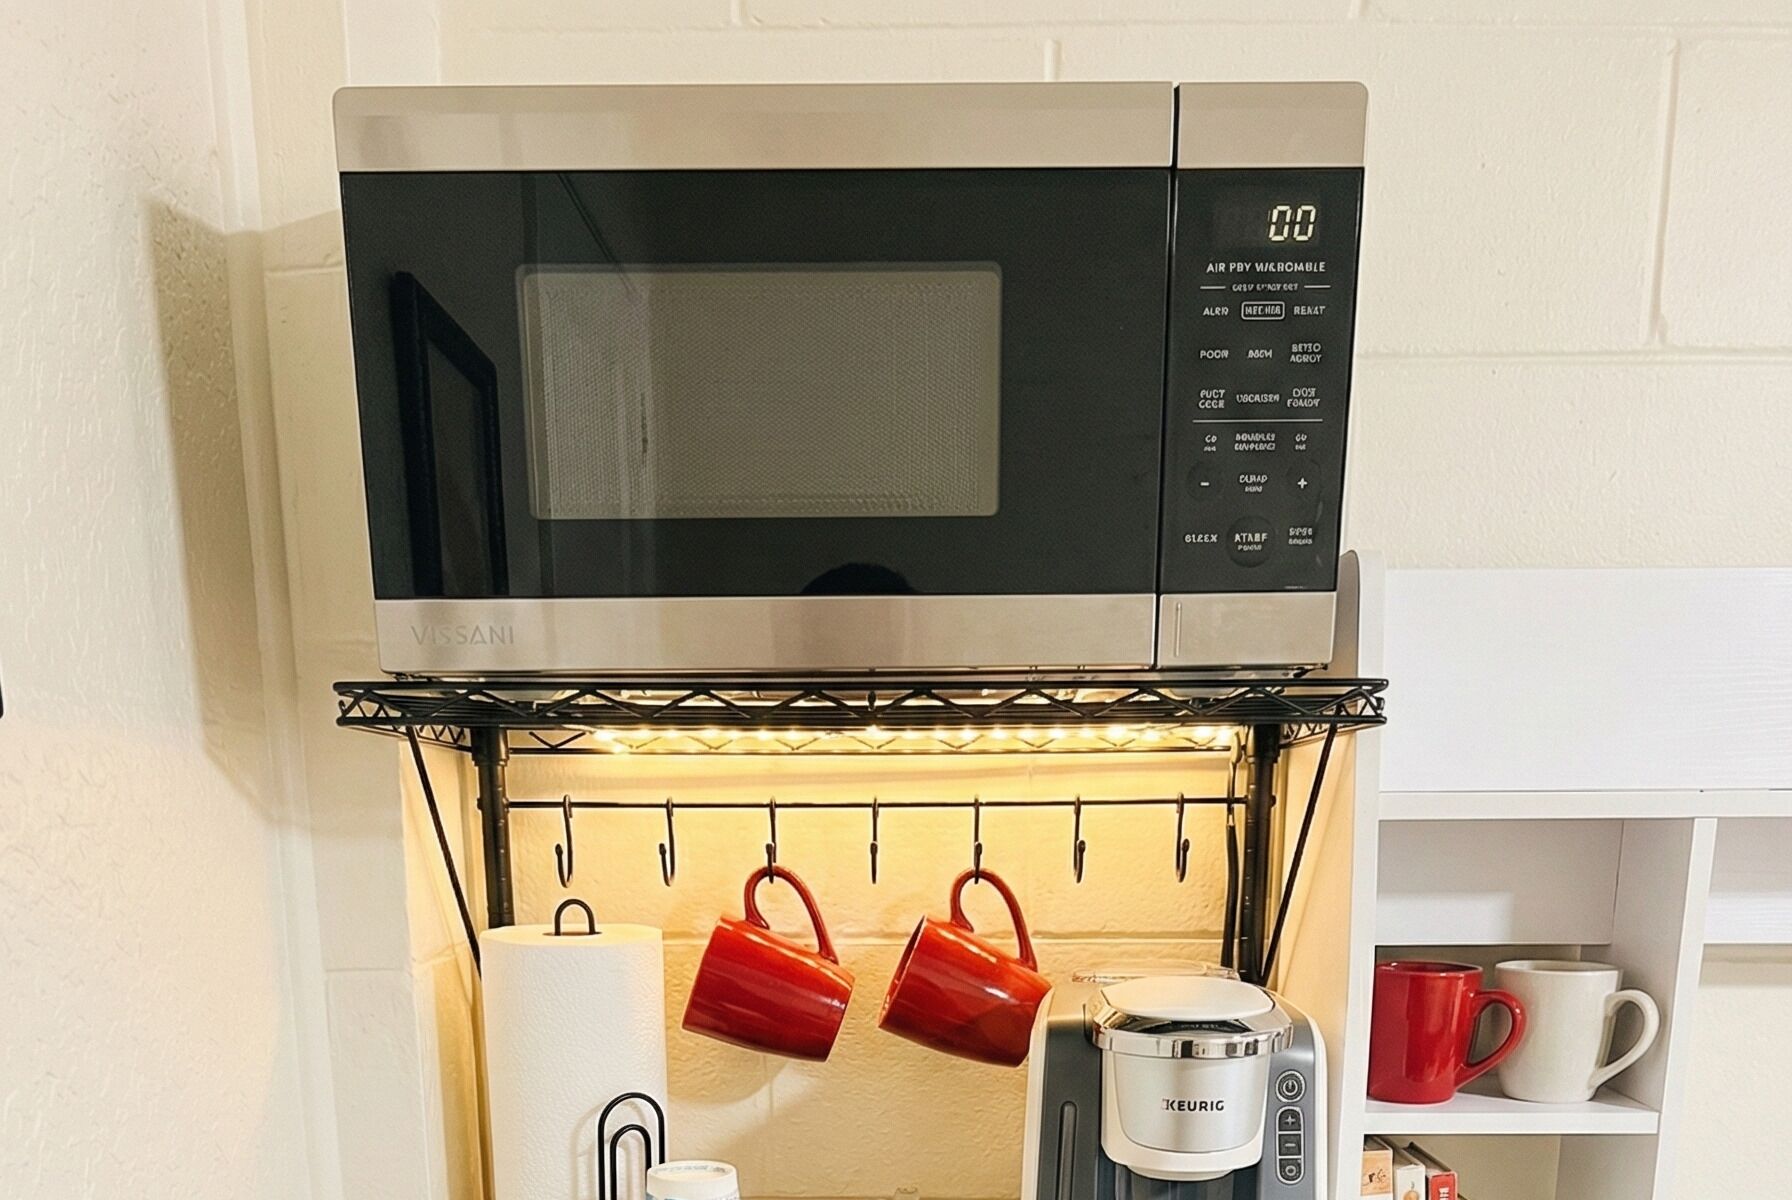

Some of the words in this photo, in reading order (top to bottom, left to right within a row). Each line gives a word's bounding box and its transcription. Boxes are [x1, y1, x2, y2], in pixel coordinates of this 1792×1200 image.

[1267, 204, 1317, 242] 00
[1206, 262, 1226, 274] AIR
[410, 624, 514, 645] VISSANI
[1164, 1099, 1225, 1112] KEURIG
